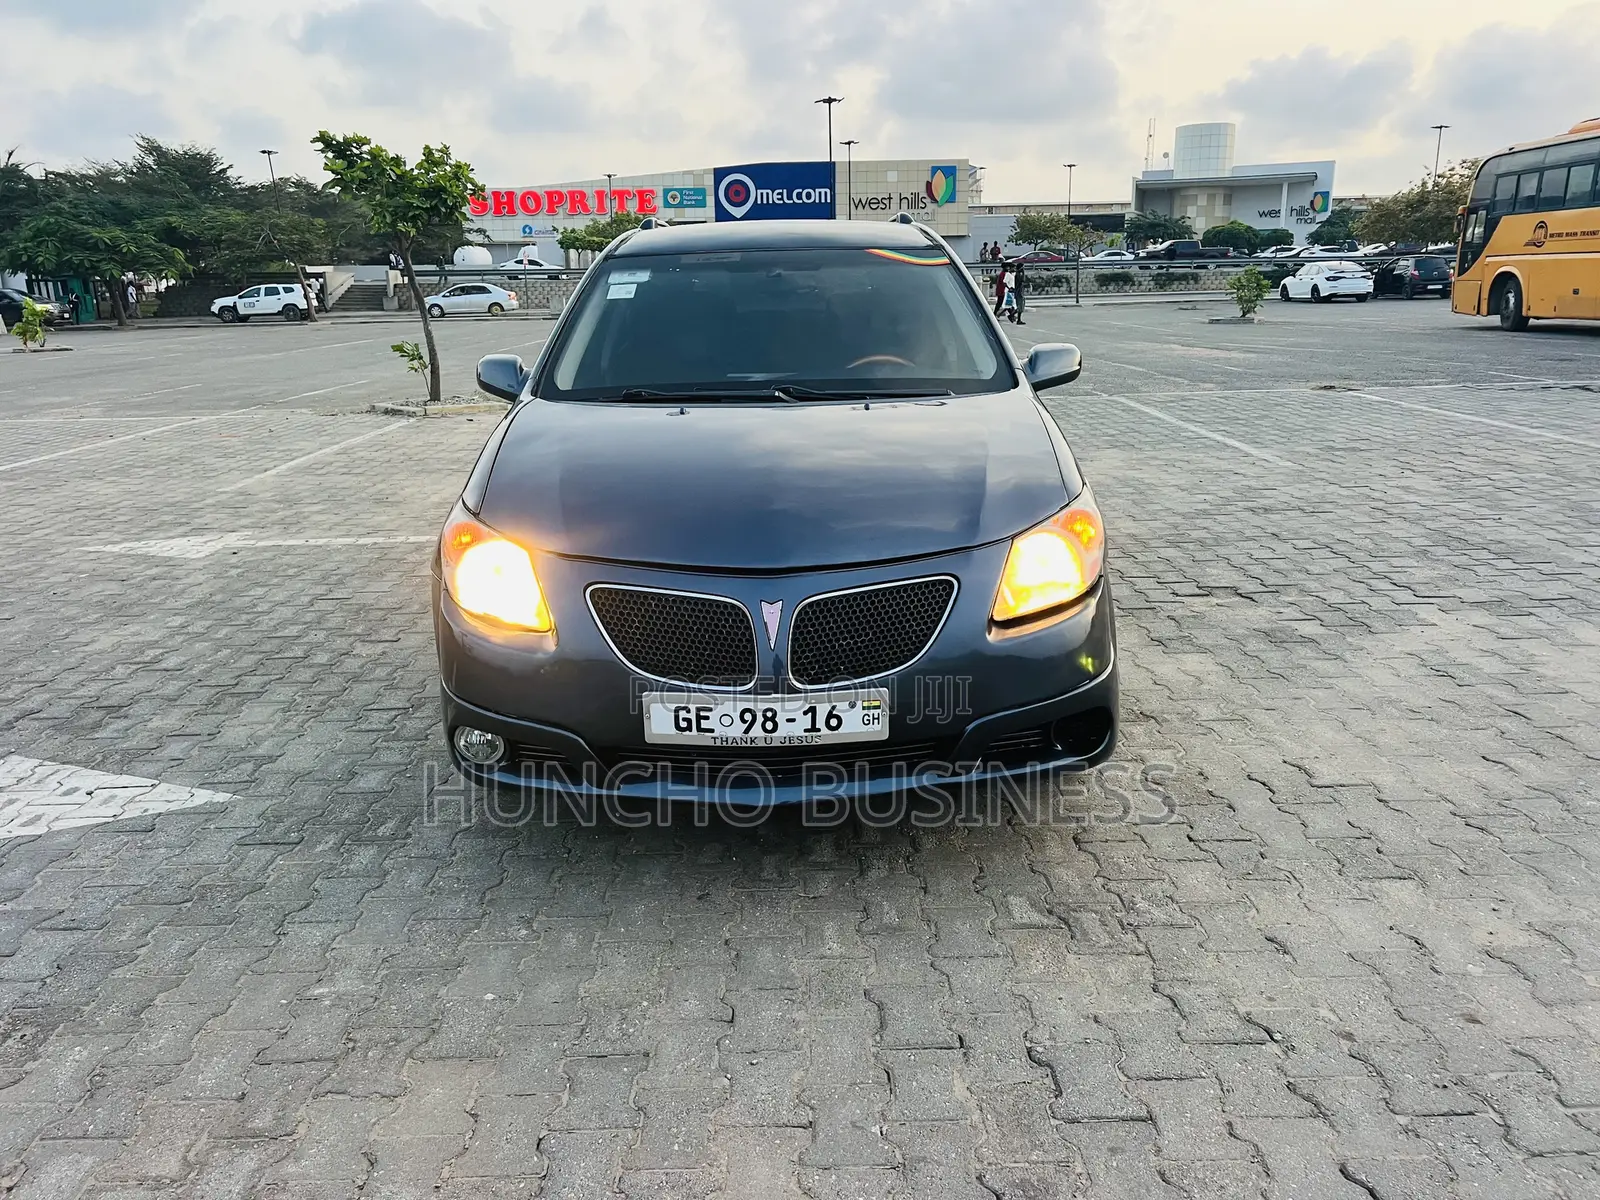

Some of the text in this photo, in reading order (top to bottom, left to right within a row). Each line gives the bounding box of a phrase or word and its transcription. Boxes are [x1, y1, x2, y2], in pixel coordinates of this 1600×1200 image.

[469, 189, 658, 217] SHOPRITE
[852, 192, 927, 211] west hills
[1257, 205, 1311, 219] wes hills
[1296, 215, 1316, 224] mall
[674, 705, 716, 734] GE
[862, 713, 880, 726] GH
[711, 735, 822, 746] THANK U JESUS
